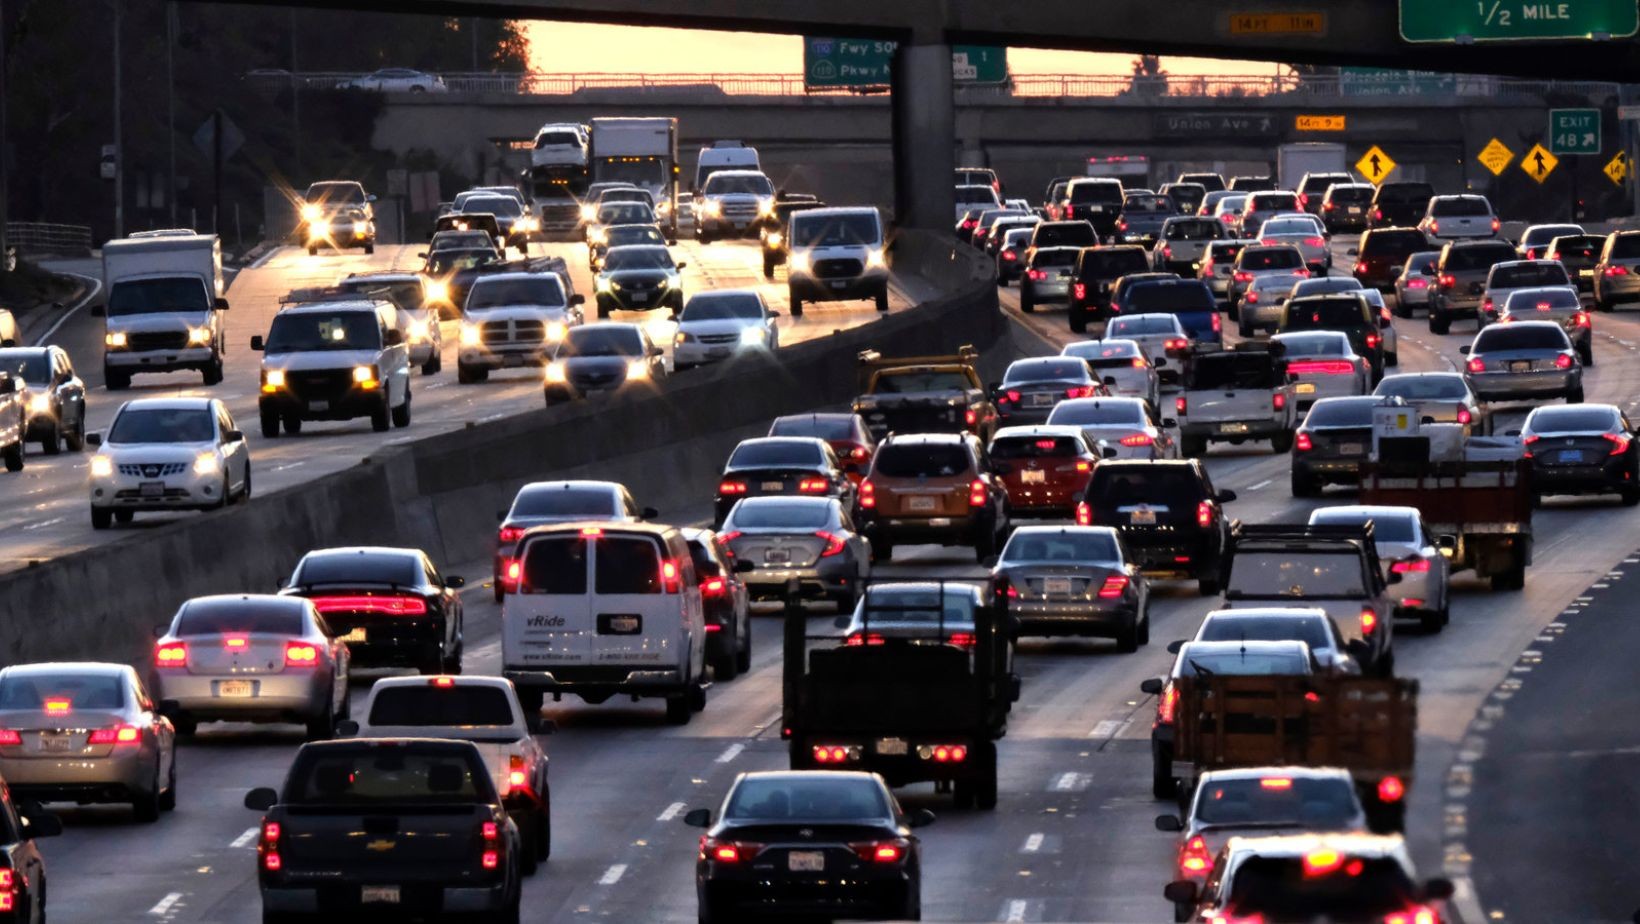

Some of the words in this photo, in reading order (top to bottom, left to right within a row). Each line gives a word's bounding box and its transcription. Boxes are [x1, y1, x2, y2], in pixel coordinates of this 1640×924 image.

[1478, 1, 1511, 25] 1/2
[1523, 4, 1570, 20] MILE
[840, 42, 868, 56] Fwy
[840, 64, 878, 76] Pkwy
[1168, 119, 1211, 130] Union
[1222, 119, 1249, 129] Ave
[1559, 116, 1591, 128] EXIT
[527, 615, 566, 627] vRide
